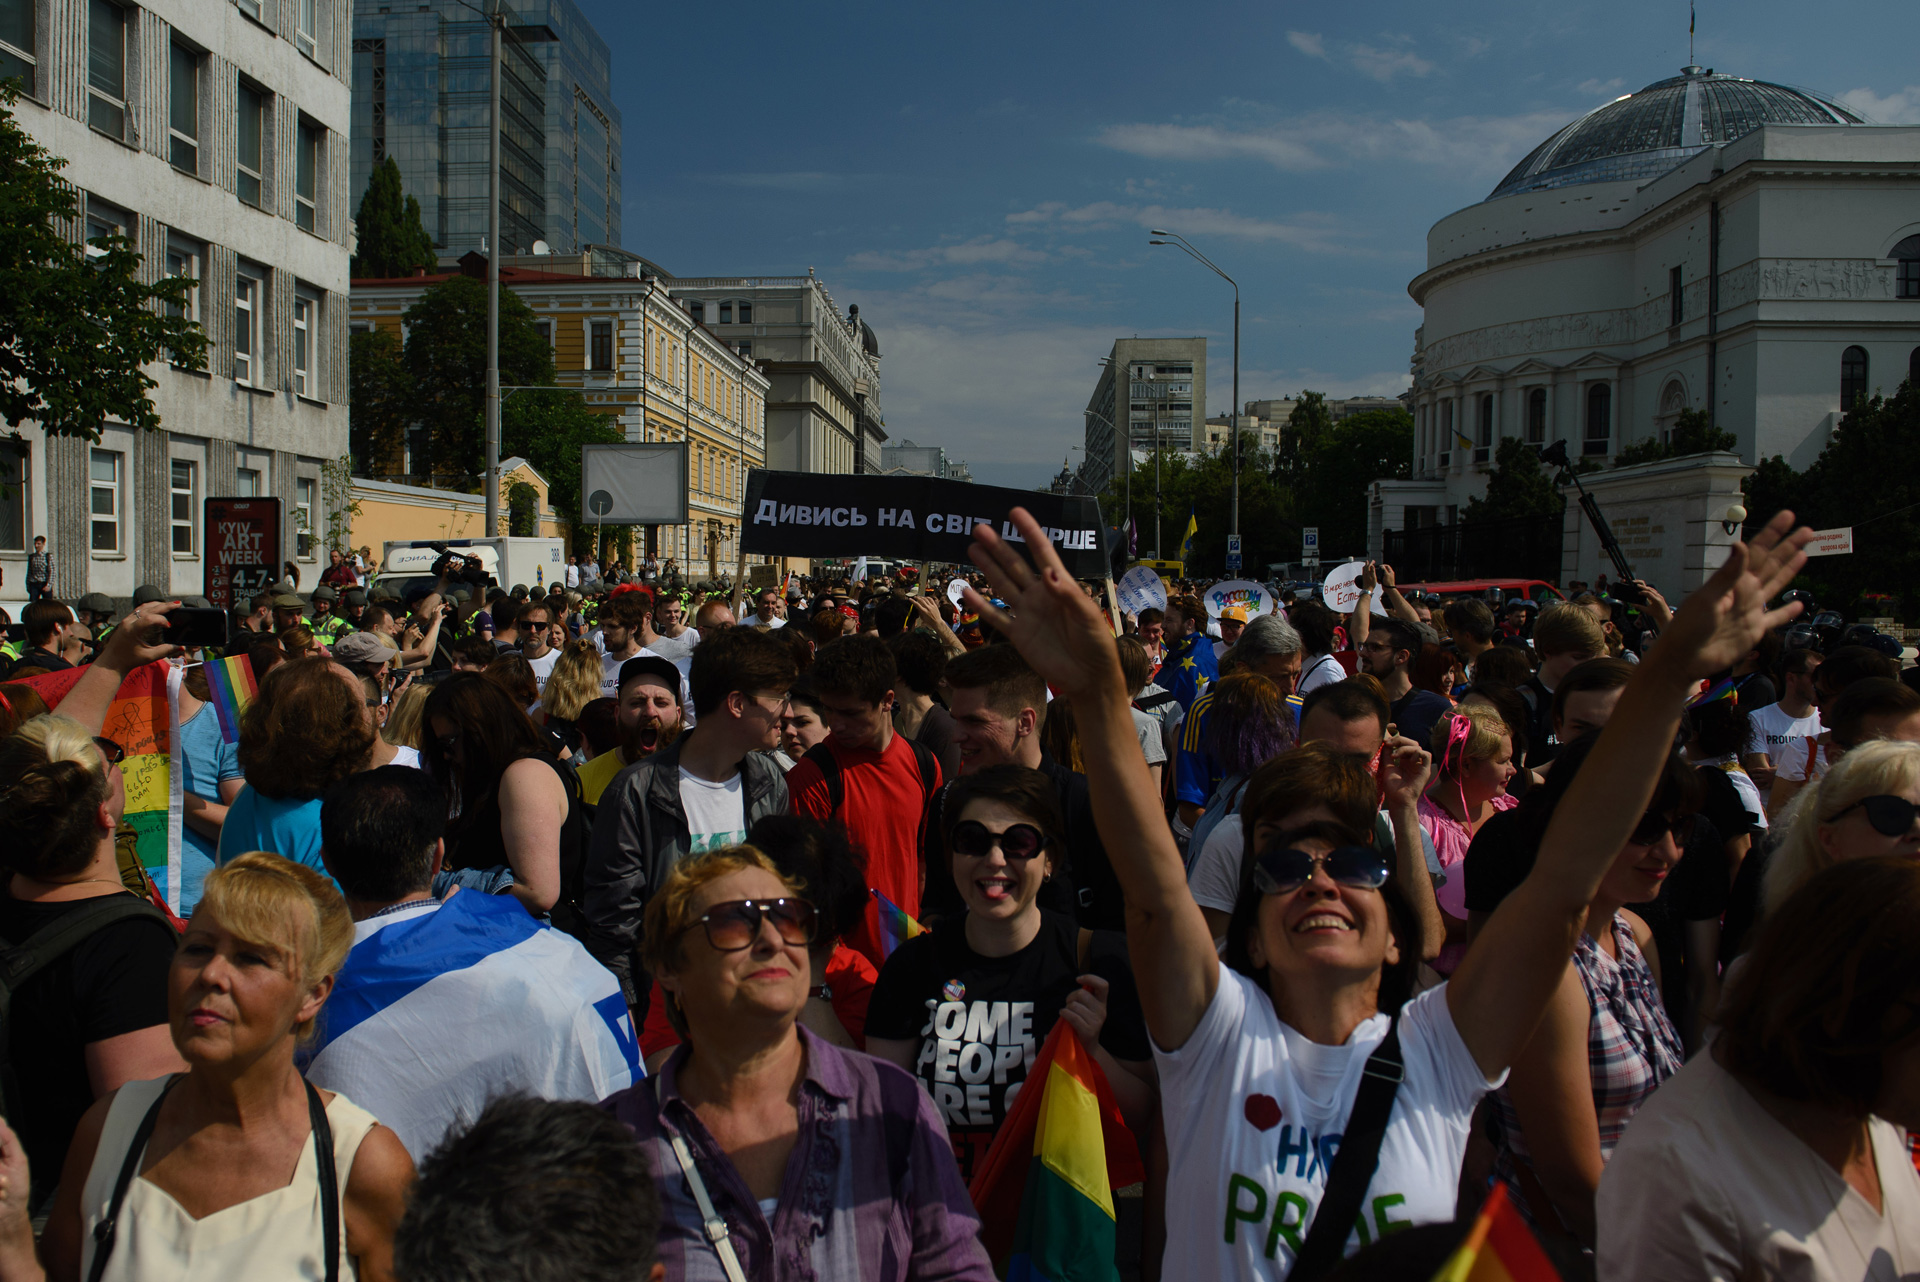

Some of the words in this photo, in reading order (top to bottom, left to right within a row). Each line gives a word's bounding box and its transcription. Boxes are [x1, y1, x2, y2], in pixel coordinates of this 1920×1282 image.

[753, 499, 867, 527] ДИВИСЬ
[877, 508, 916, 530] НА
[218, 522, 251, 535] KYIV
[223, 533, 264, 550] ART
[218, 550, 263, 565] WEEK
[232, 569, 268, 588] 4-7
[232, 588, 265, 597] ТРАВН
[1324, 585, 1329, 595] В
[1337, 592, 1361, 606] Есть
[916, 1034, 1036, 1085] PEOPL
[917, 1076, 994, 1126] RE
